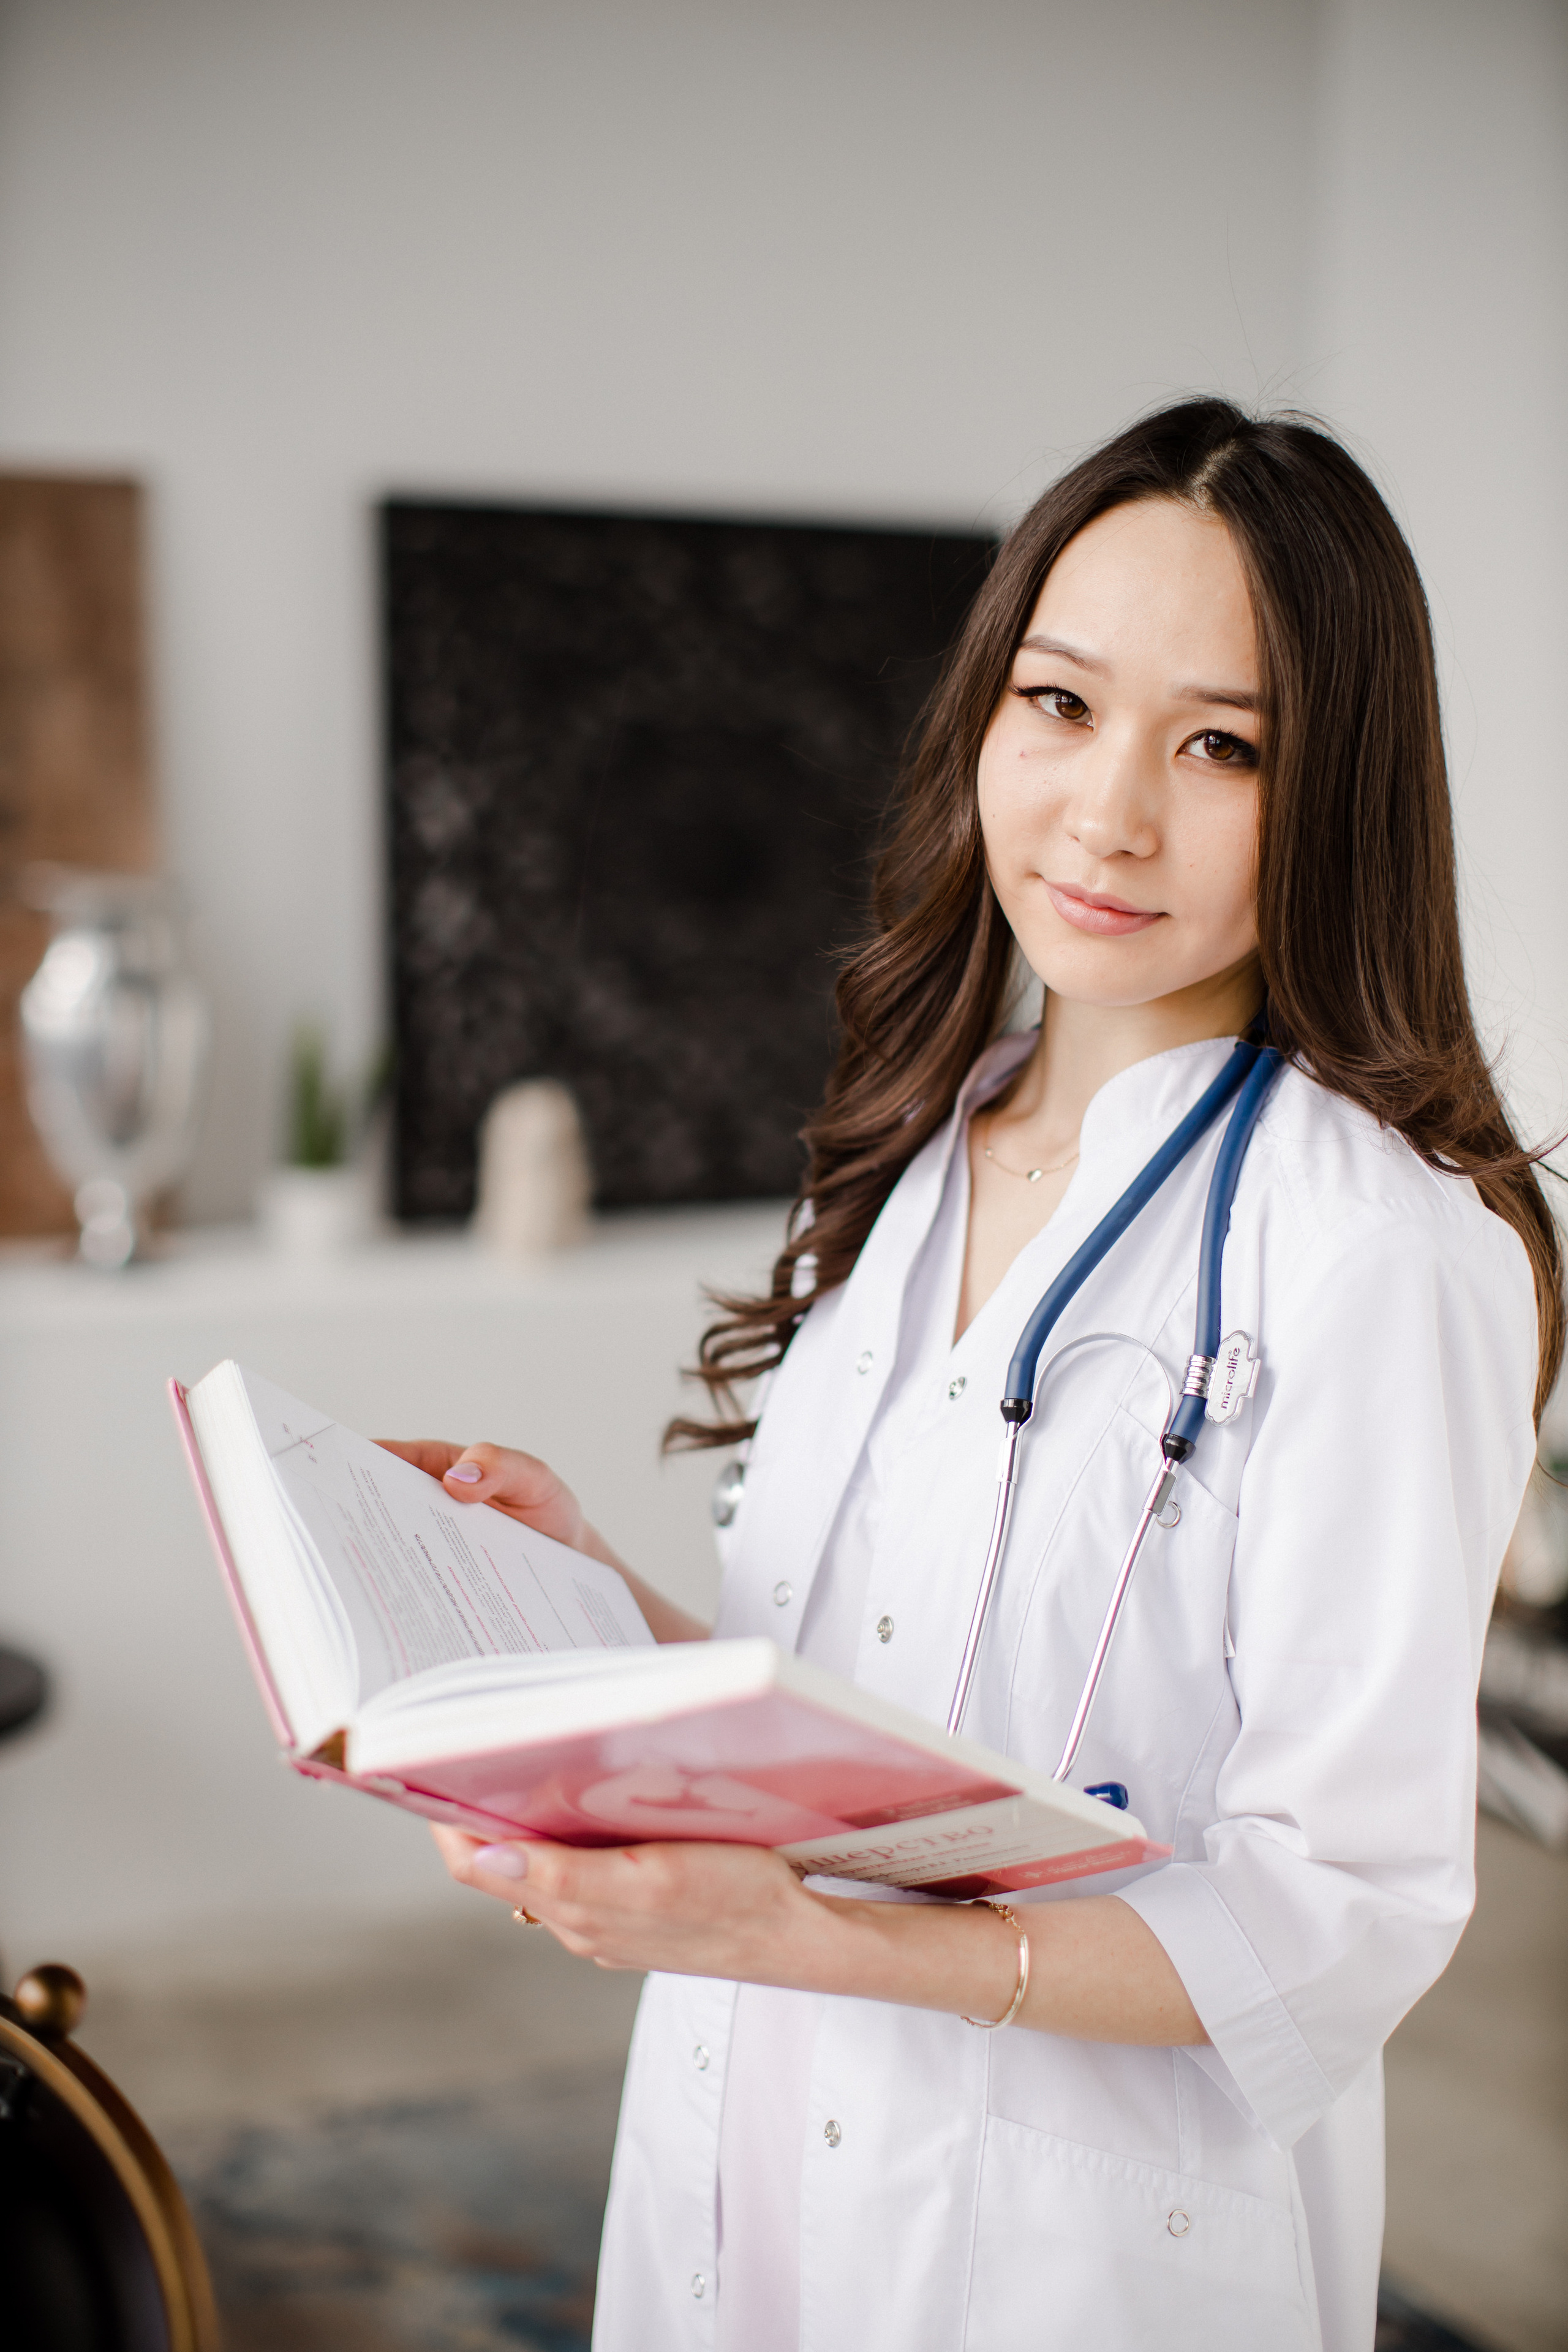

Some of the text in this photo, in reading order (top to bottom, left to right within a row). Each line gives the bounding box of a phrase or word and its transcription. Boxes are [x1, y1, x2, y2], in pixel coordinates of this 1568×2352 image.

[415, 1534, 459, 1608] НЕДОСТАТОЧНОСТЬ
[456, 1608, 485, 1656] ЦЕНТАРНАЯ
[789, 1825, 993, 1876] ушерство
